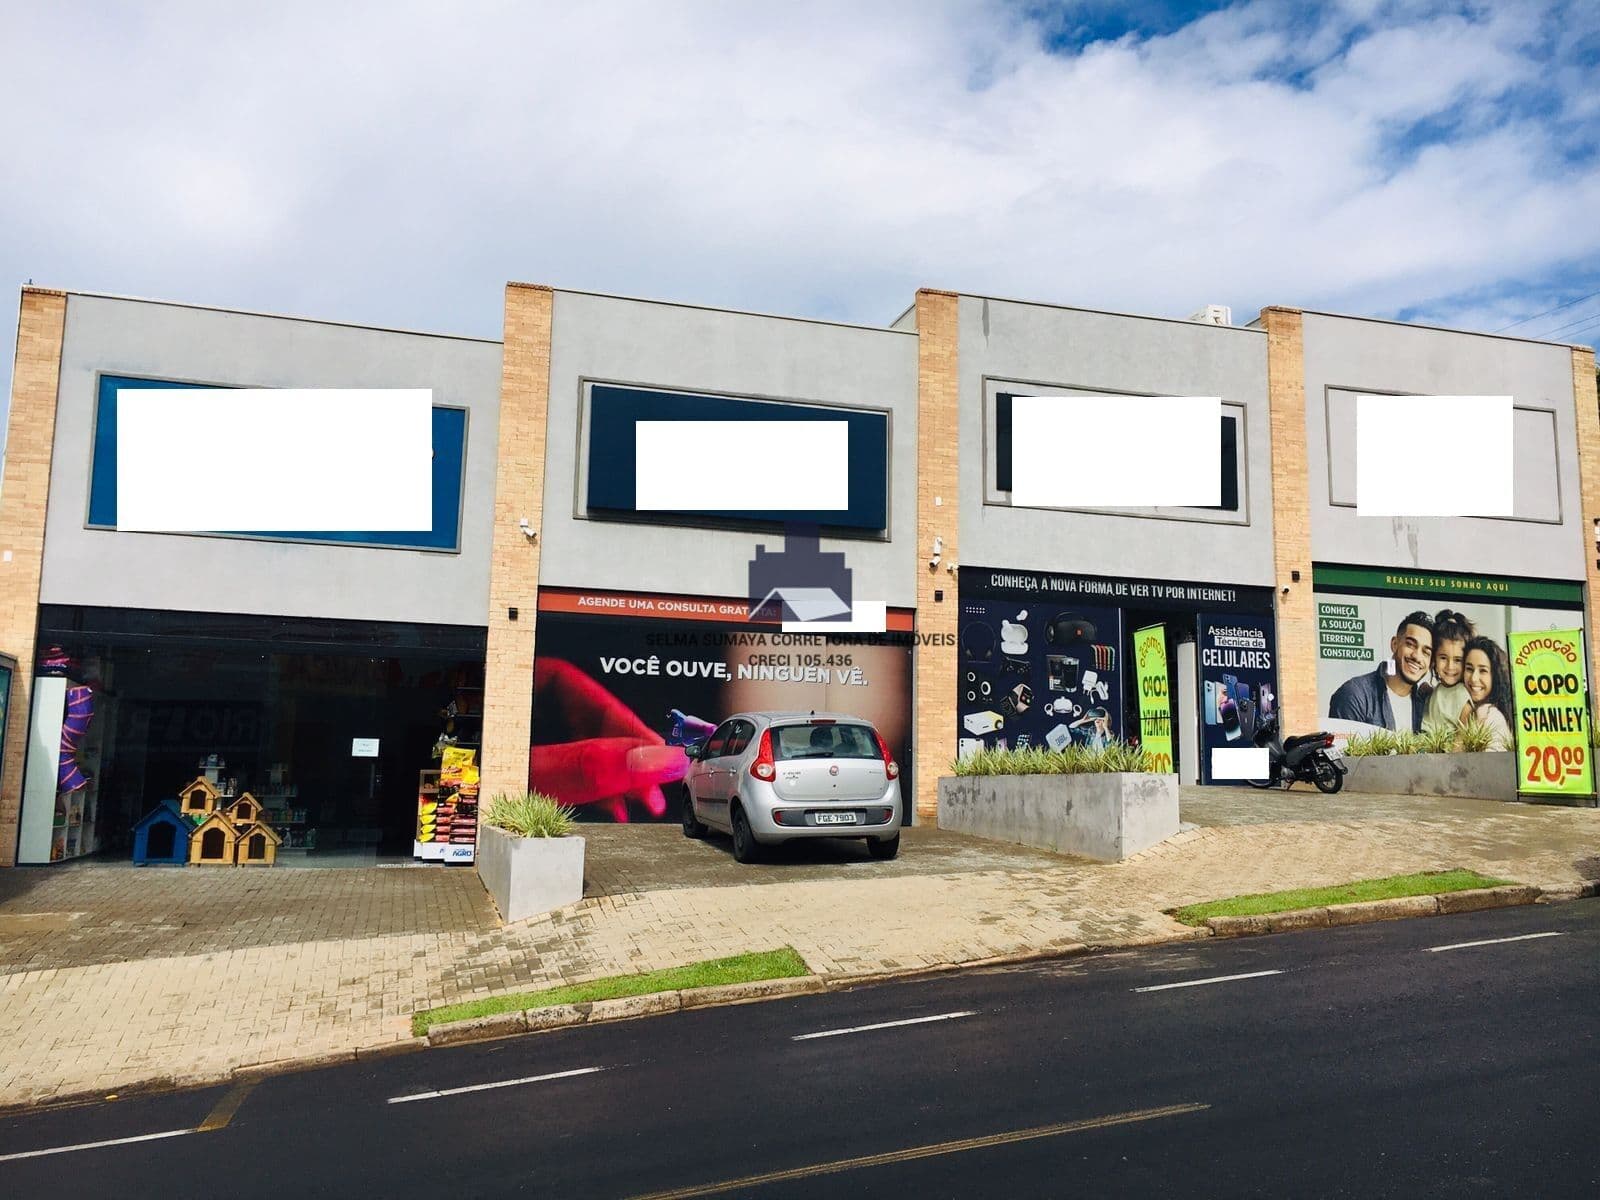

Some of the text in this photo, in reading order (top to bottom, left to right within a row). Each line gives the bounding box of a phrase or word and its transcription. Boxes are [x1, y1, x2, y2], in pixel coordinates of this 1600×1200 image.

[991, 574, 1038, 592] CONHEÇA
[1041, 577, 1049, 590] A
[1050, 578, 1077, 592] NOVA
[1115, 583, 1129, 596] DE
[1131, 583, 1150, 597] VER
[1151, 585, 1164, 598] TV
[1165, 586, 1185, 599] POR
[1187, 588, 1236, 602] INTERNET!
[1386, 575, 1509, 593] REALIZE SEU SONHO AQUI
[578, 596, 626, 608] AGENDE
[629, 599, 655, 610] UMA
[657, 601, 716, 615] CONSULTA
[1321, 605, 1356, 617] CONHEÇA
[1208, 626, 1264, 638] Assistência
[1321, 619, 1363, 632] A SOLUÇÃO
[1217, 636, 1264, 648] Técnica de
[1322, 634, 1356, 645] TERRENO
[1202, 649, 1271, 669] CELULARES
[1322, 648, 1372, 661] CONSTRUÇÃO
[1515, 638, 1577, 666] Promoção
[600, 655, 661, 676] VOCÊ
[666, 660, 732, 682] OUVE,
[835, 667, 868, 686] VÊ.
[1524, 673, 1579, 696] COPO
[1522, 707, 1583, 732] STANLEY
